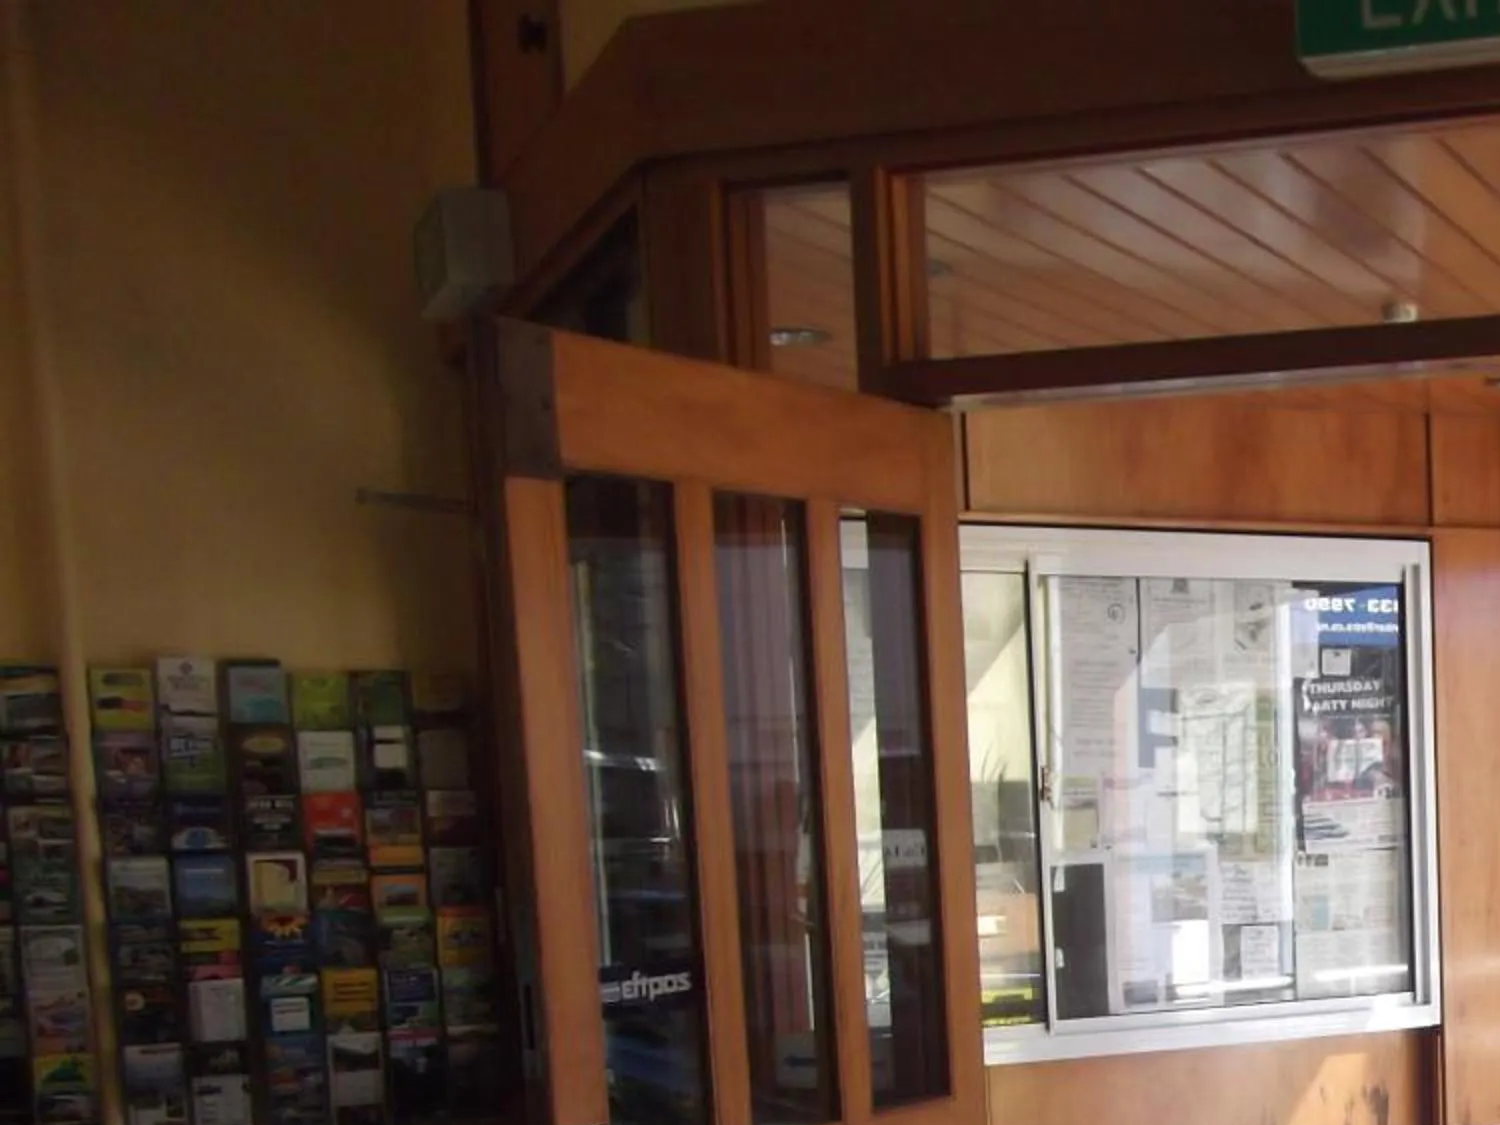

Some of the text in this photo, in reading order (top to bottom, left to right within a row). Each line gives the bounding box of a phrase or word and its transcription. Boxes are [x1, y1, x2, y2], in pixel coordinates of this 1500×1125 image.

[1310, 680, 1380, 694] THURSDAY
[1351, 696, 1393, 709] NIGHT
[621, 970, 692, 1003] eftpos
